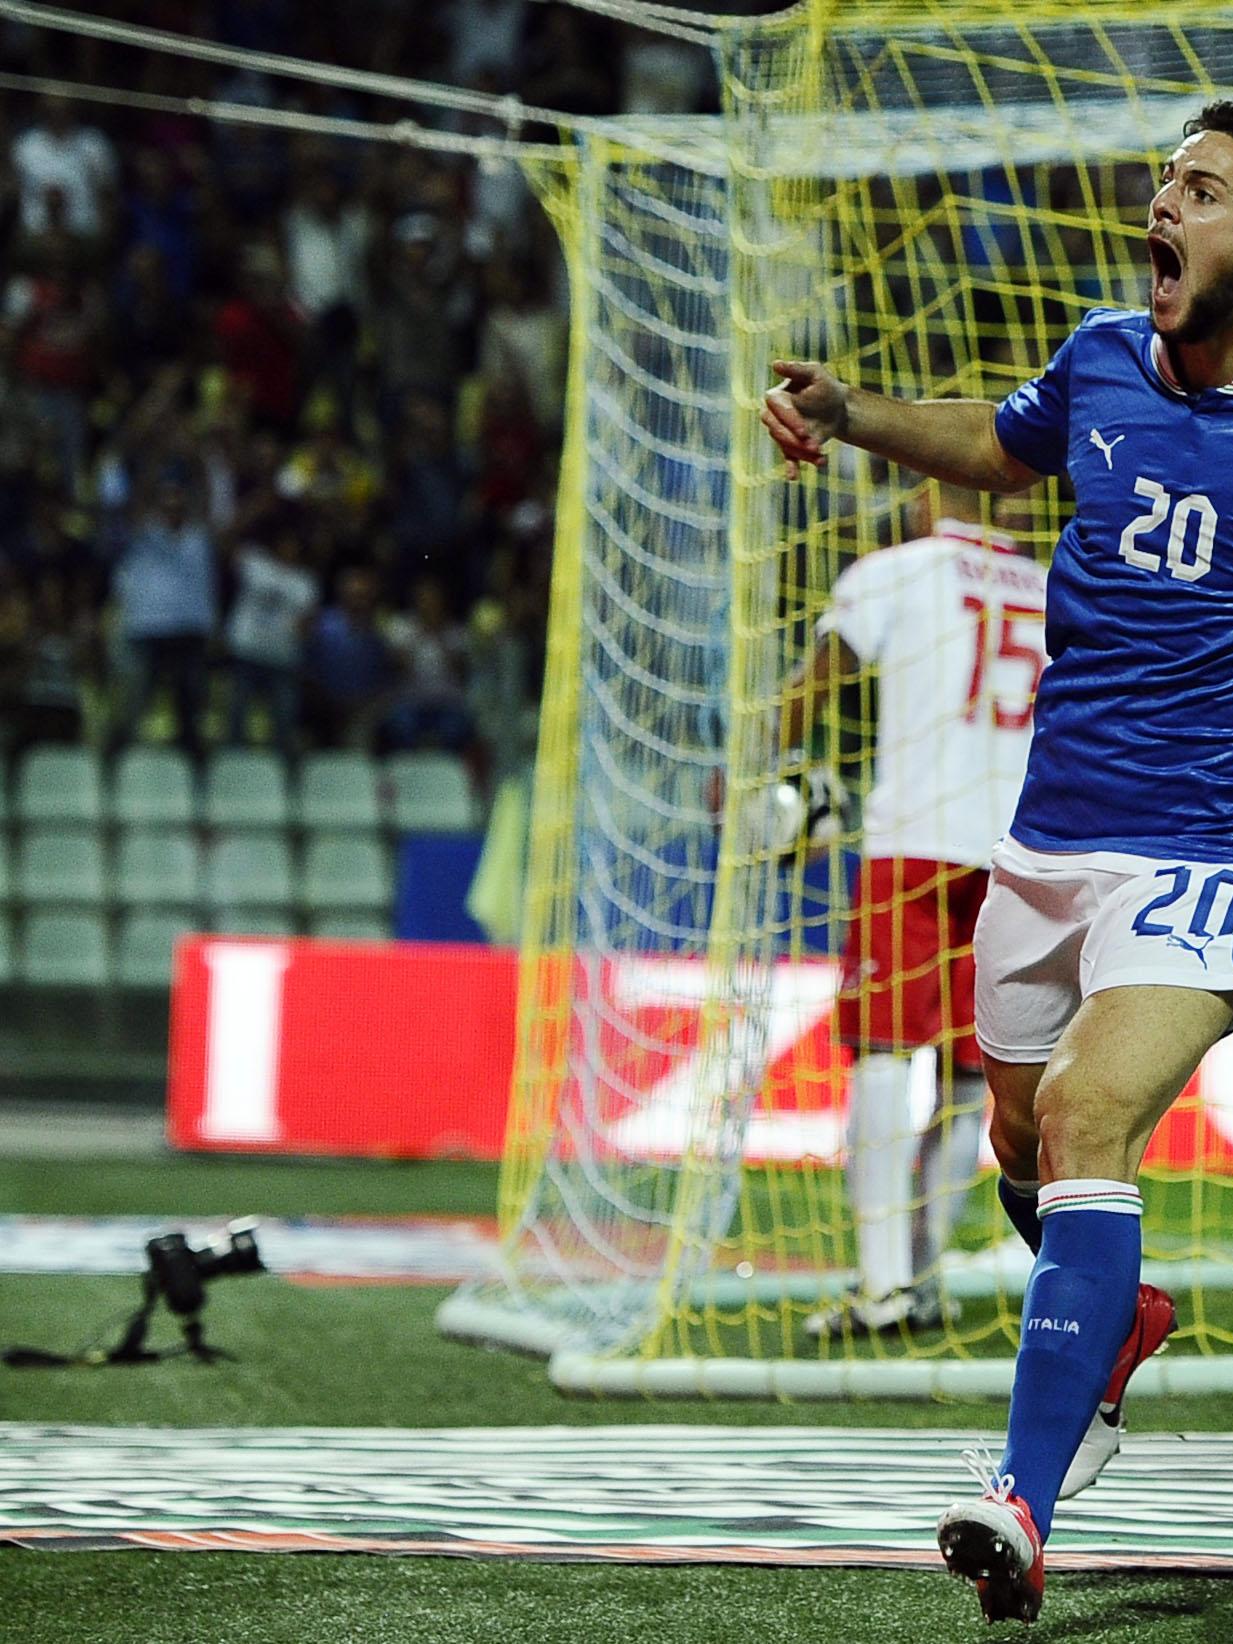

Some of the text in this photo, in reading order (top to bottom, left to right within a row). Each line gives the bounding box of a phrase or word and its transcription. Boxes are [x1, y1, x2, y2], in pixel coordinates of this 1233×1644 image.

[1118, 476, 1217, 581] 20
[962, 595, 1043, 729] 15
[1028, 1317, 1080, 1335] ITALIA
